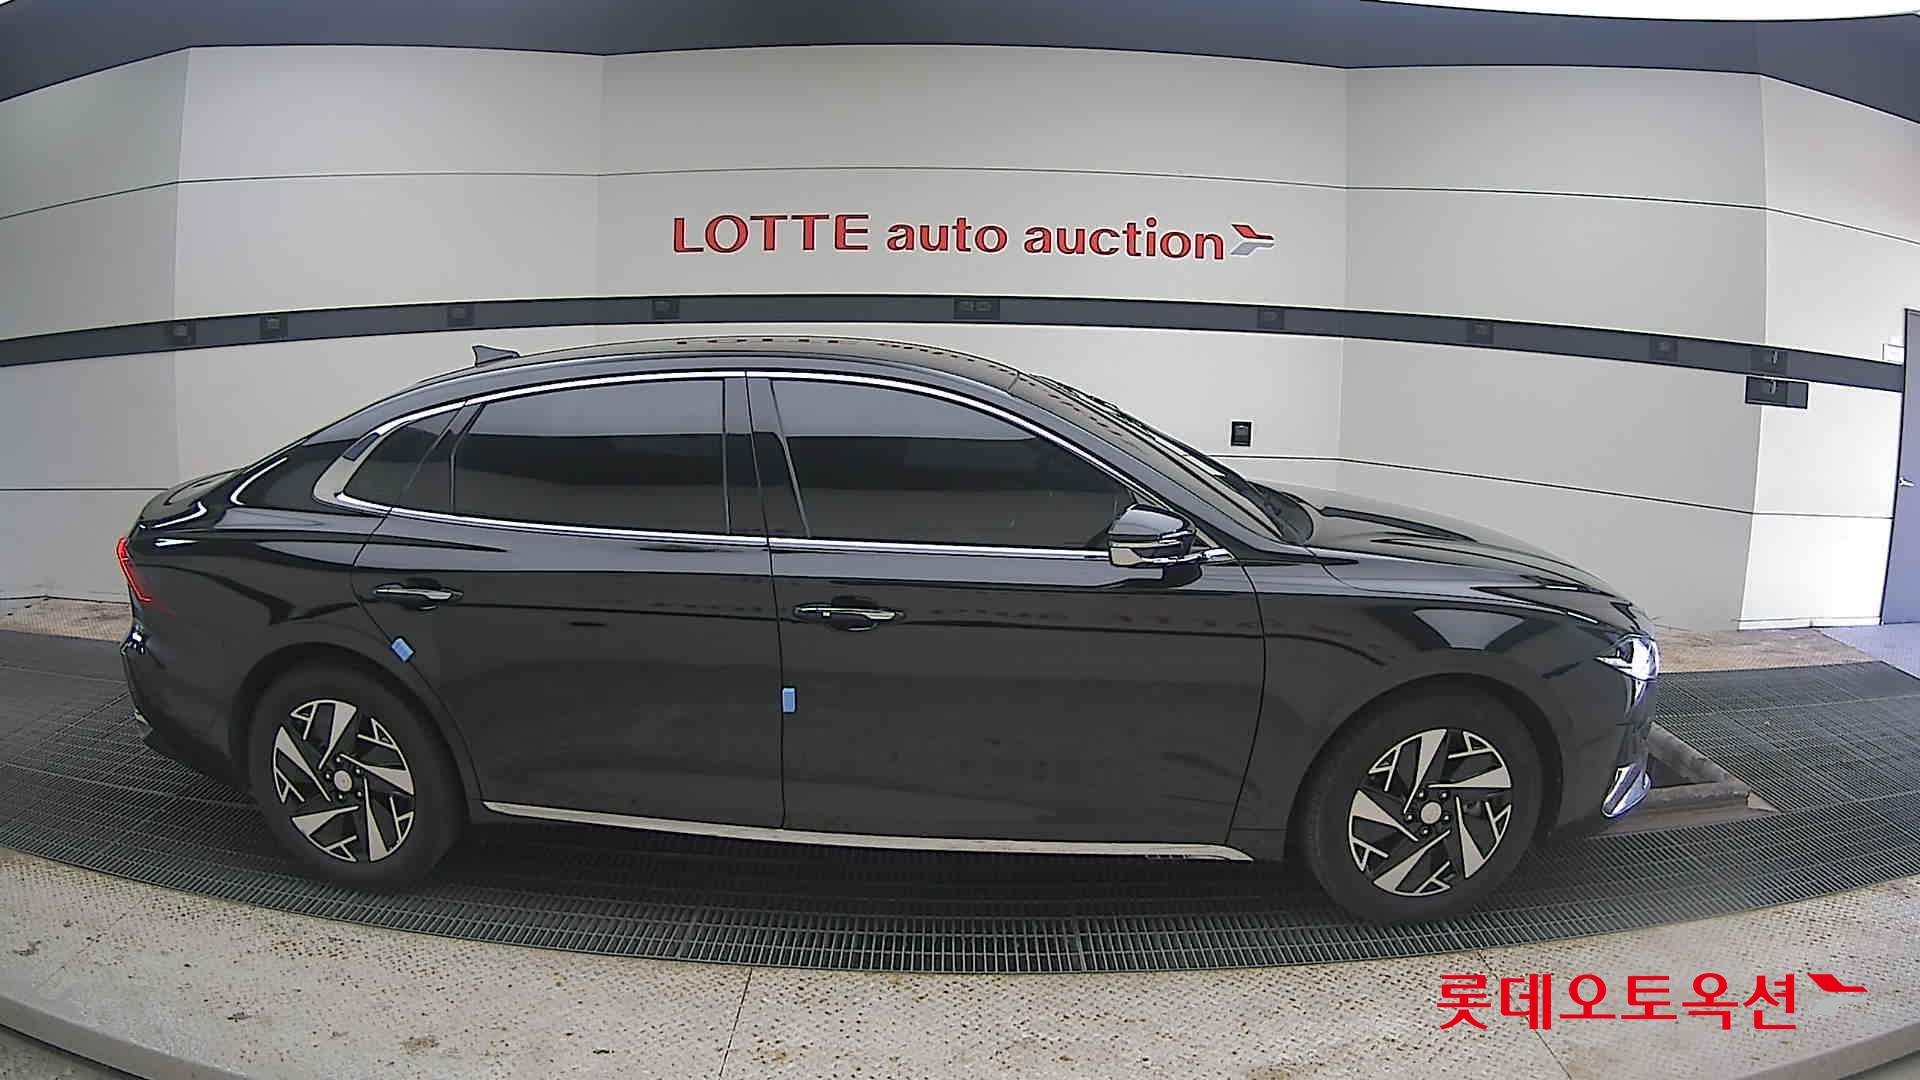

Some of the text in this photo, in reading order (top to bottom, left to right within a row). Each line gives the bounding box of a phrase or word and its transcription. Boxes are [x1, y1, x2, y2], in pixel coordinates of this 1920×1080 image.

[673, 214, 1225, 260] LOTTE auto auction
